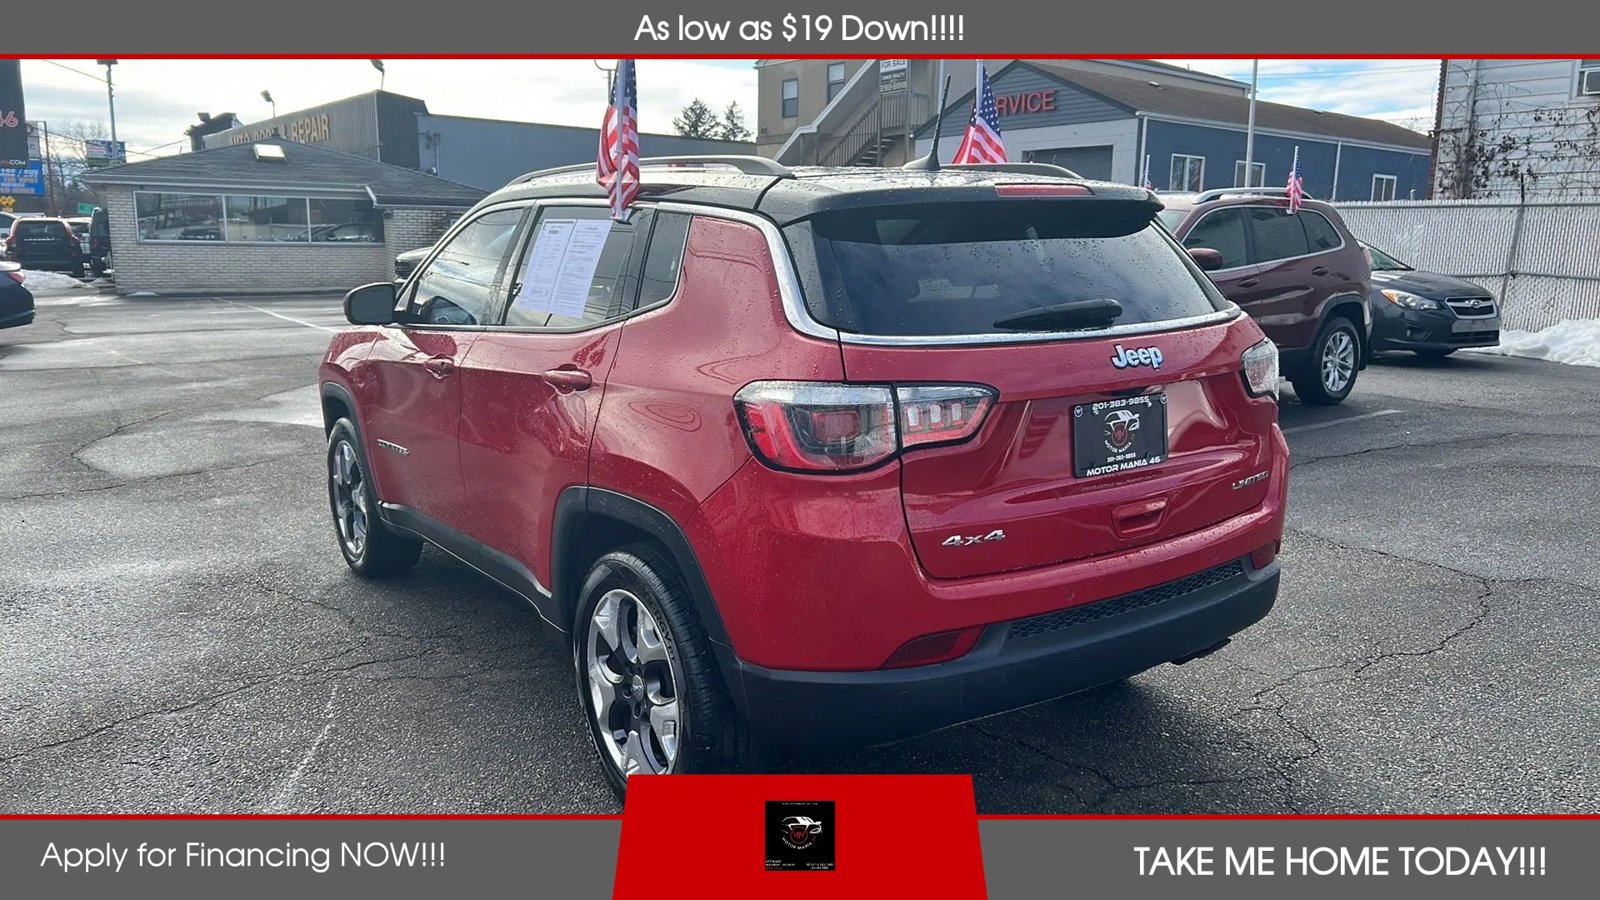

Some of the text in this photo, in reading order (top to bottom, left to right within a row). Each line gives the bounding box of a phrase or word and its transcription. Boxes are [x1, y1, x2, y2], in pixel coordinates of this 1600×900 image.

[969, 87, 1056, 115] RVICE
[292, 113, 330, 143] REPAIR
[1110, 344, 1164, 369] Jeep
[1092, 396, 1151, 410] 201-383-9855
[1086, 456, 1161, 477] MOTOR MANIA 46
